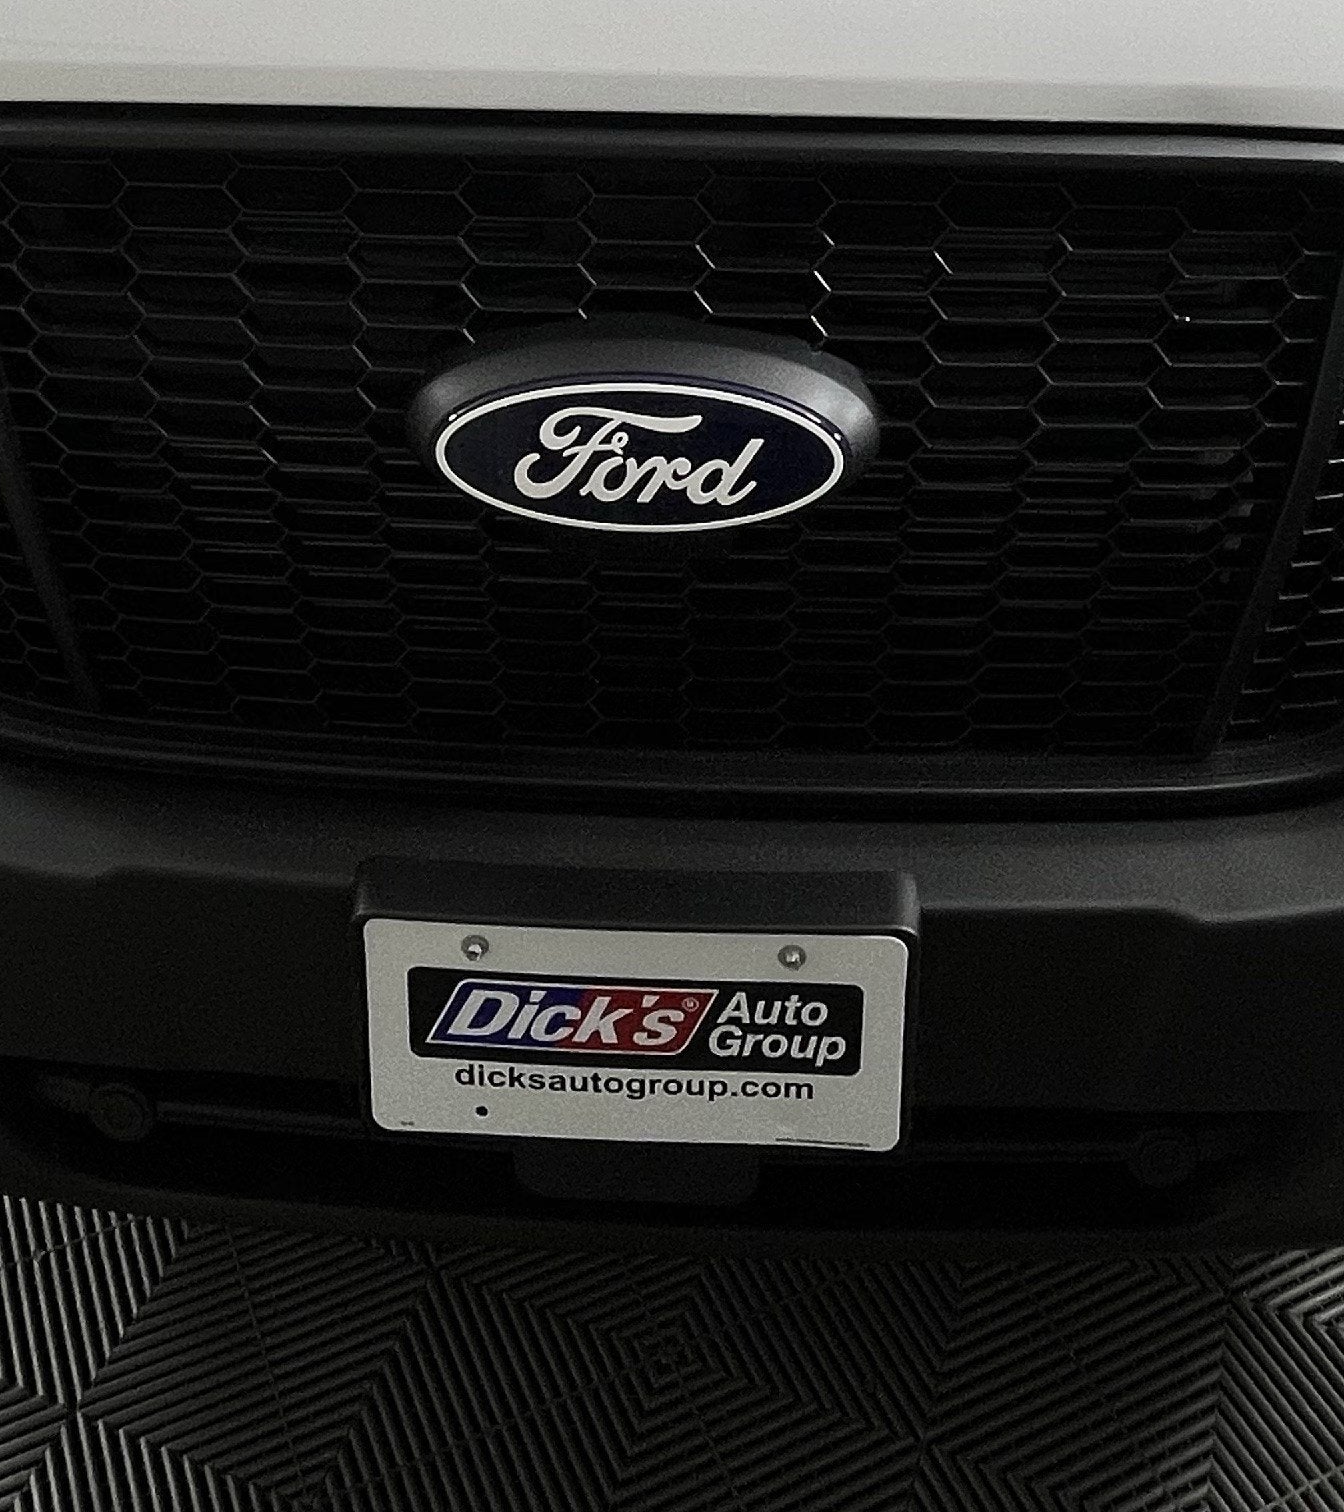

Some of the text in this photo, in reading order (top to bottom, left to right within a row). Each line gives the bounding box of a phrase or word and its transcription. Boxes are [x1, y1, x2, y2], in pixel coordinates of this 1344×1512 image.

[513, 406, 764, 505] Ford
[446, 988, 686, 1048] Dick's
[717, 991, 829, 1026] Auto
[708, 1025, 847, 1068] Group
[455, 1063, 815, 1101] dicksautogroup.com
